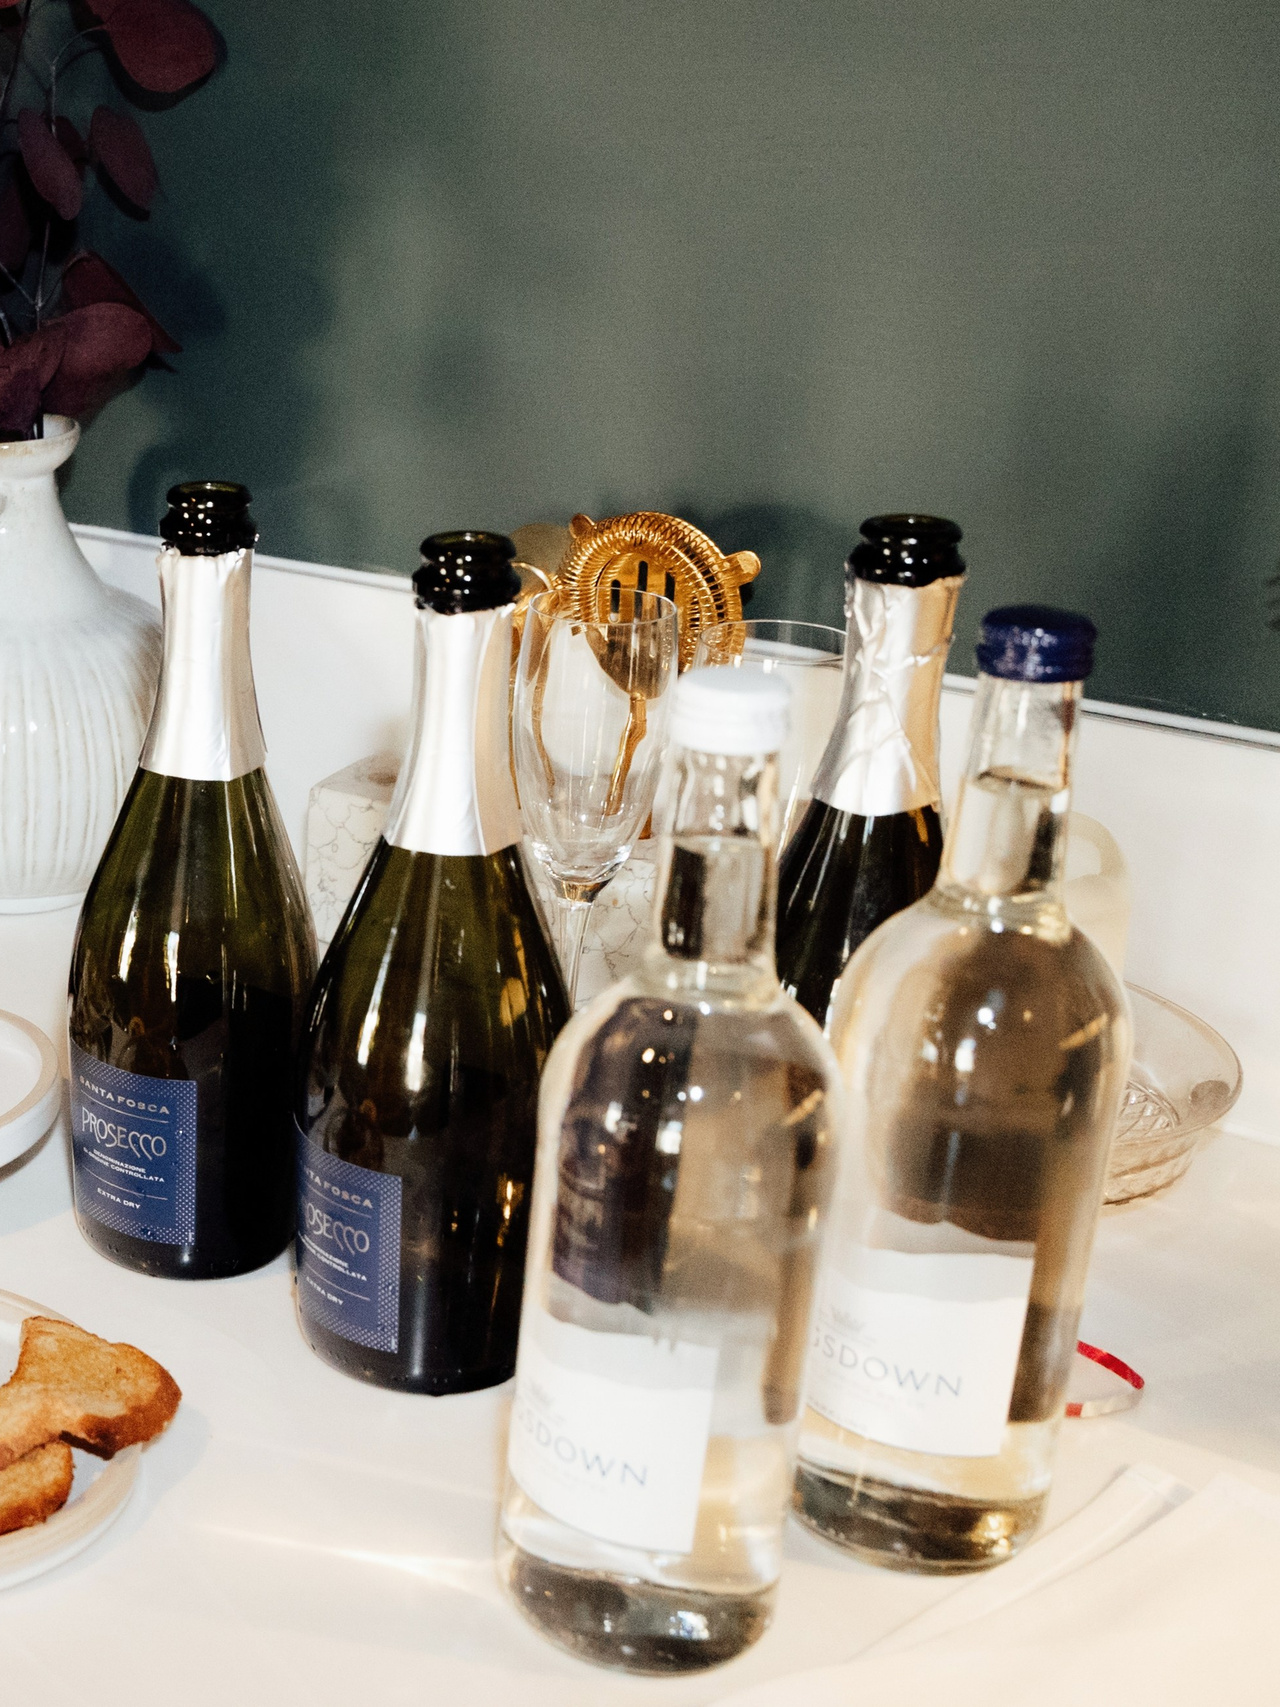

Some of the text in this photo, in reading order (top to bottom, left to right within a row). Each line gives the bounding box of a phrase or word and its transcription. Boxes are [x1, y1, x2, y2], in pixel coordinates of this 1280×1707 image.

[81, 1106, 167, 1161] PROSECCO
[111, 1164, 165, 1183] CONTROLLATA
[97, 1187, 141, 1210] EXTRA DRY
[304, 1202, 370, 1256] OSECCO
